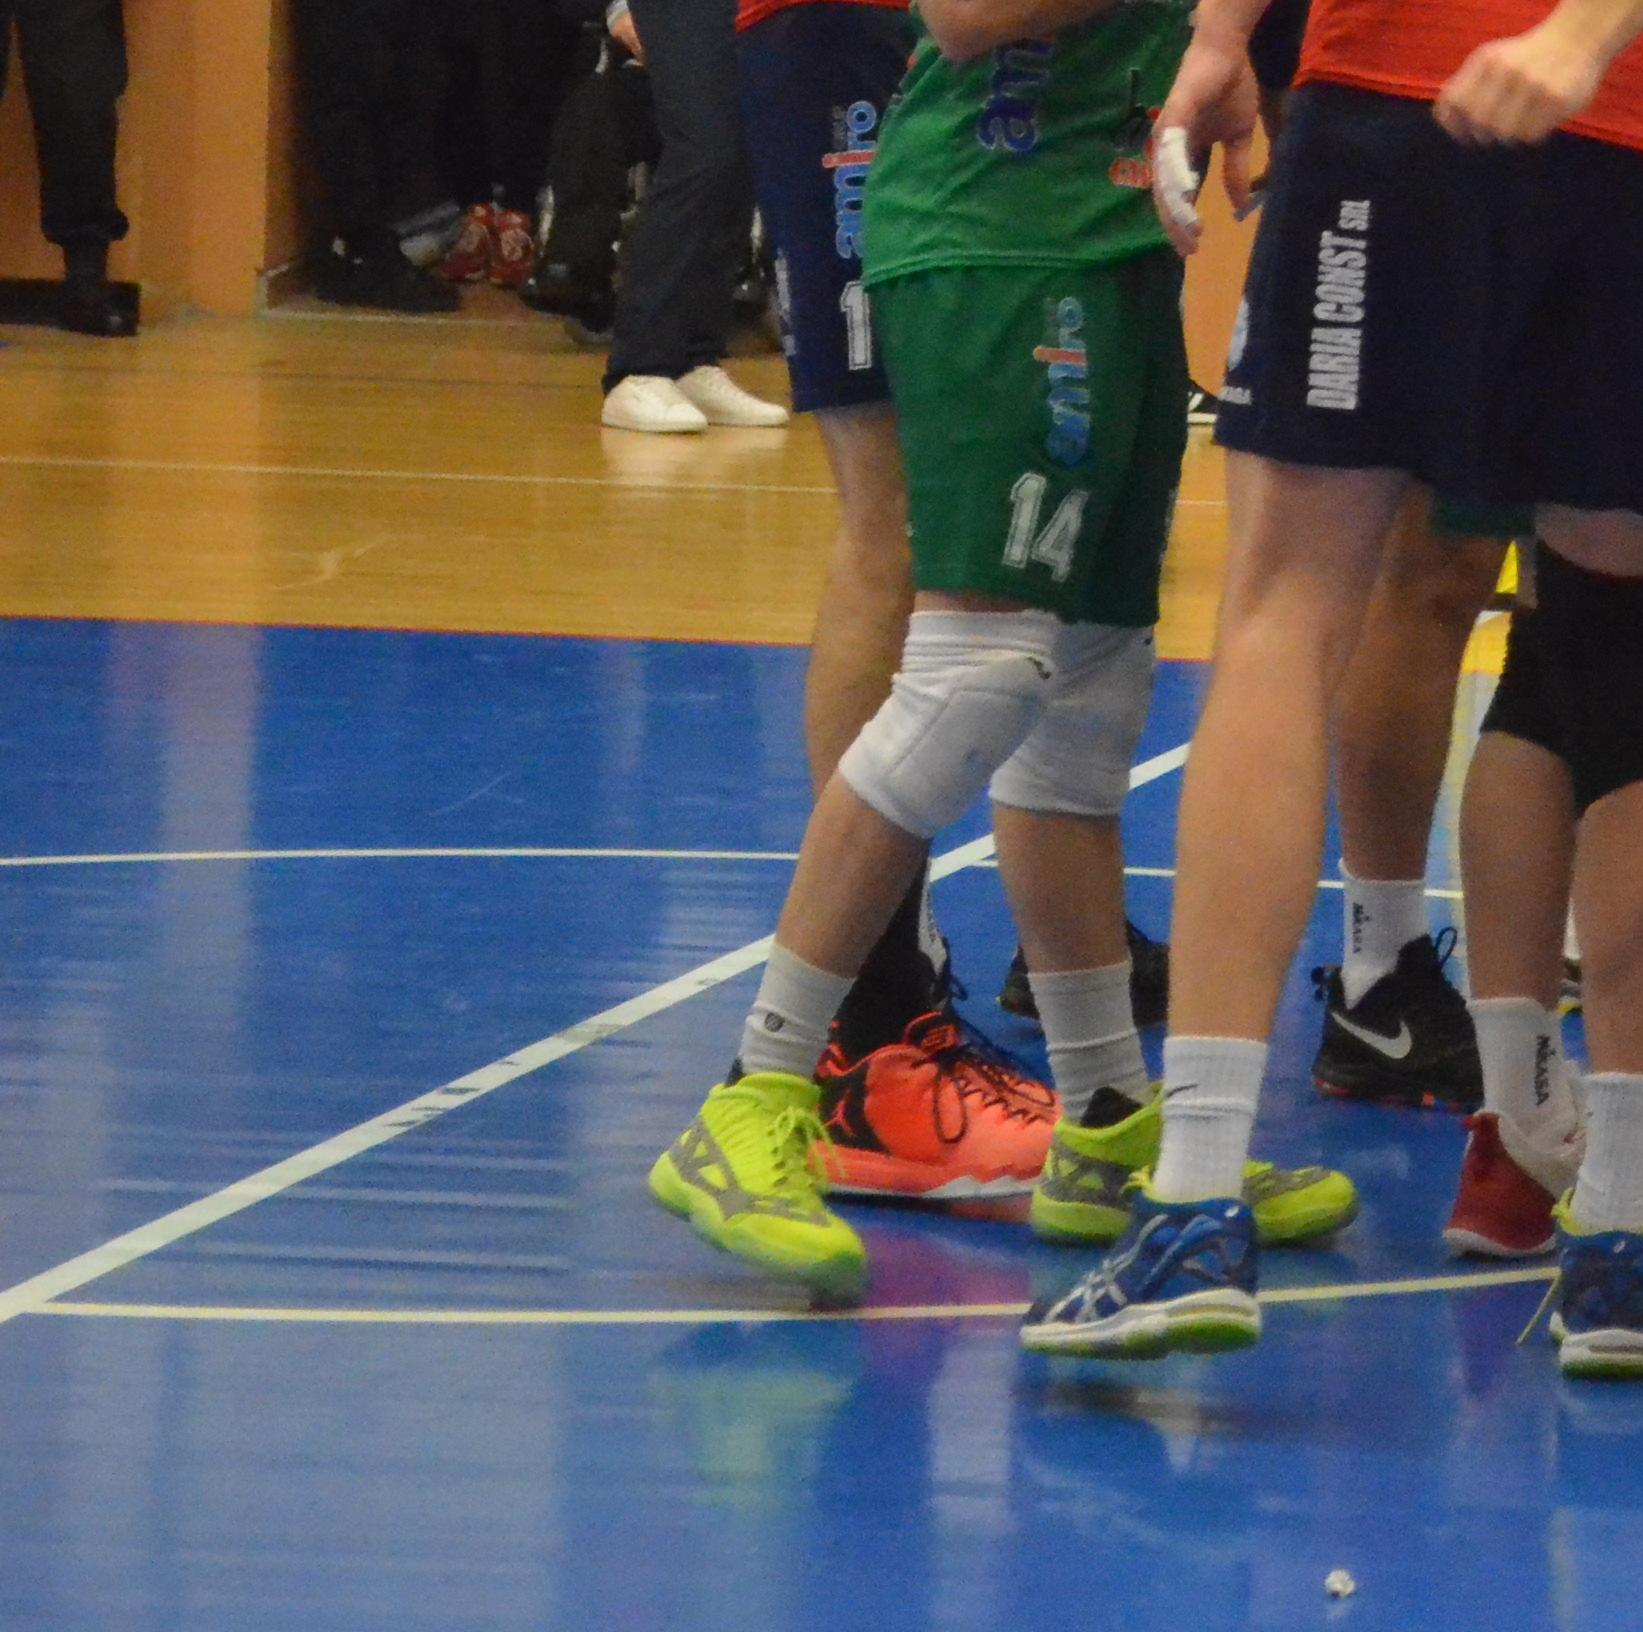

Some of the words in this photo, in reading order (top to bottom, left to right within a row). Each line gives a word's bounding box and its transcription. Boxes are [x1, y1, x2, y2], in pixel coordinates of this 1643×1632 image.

[1336, 199, 1371, 232] SRL
[1313, 229, 1368, 323] CONST
[1306, 326, 1363, 410] DARIA
[1001, 472, 1090, 585] 14
